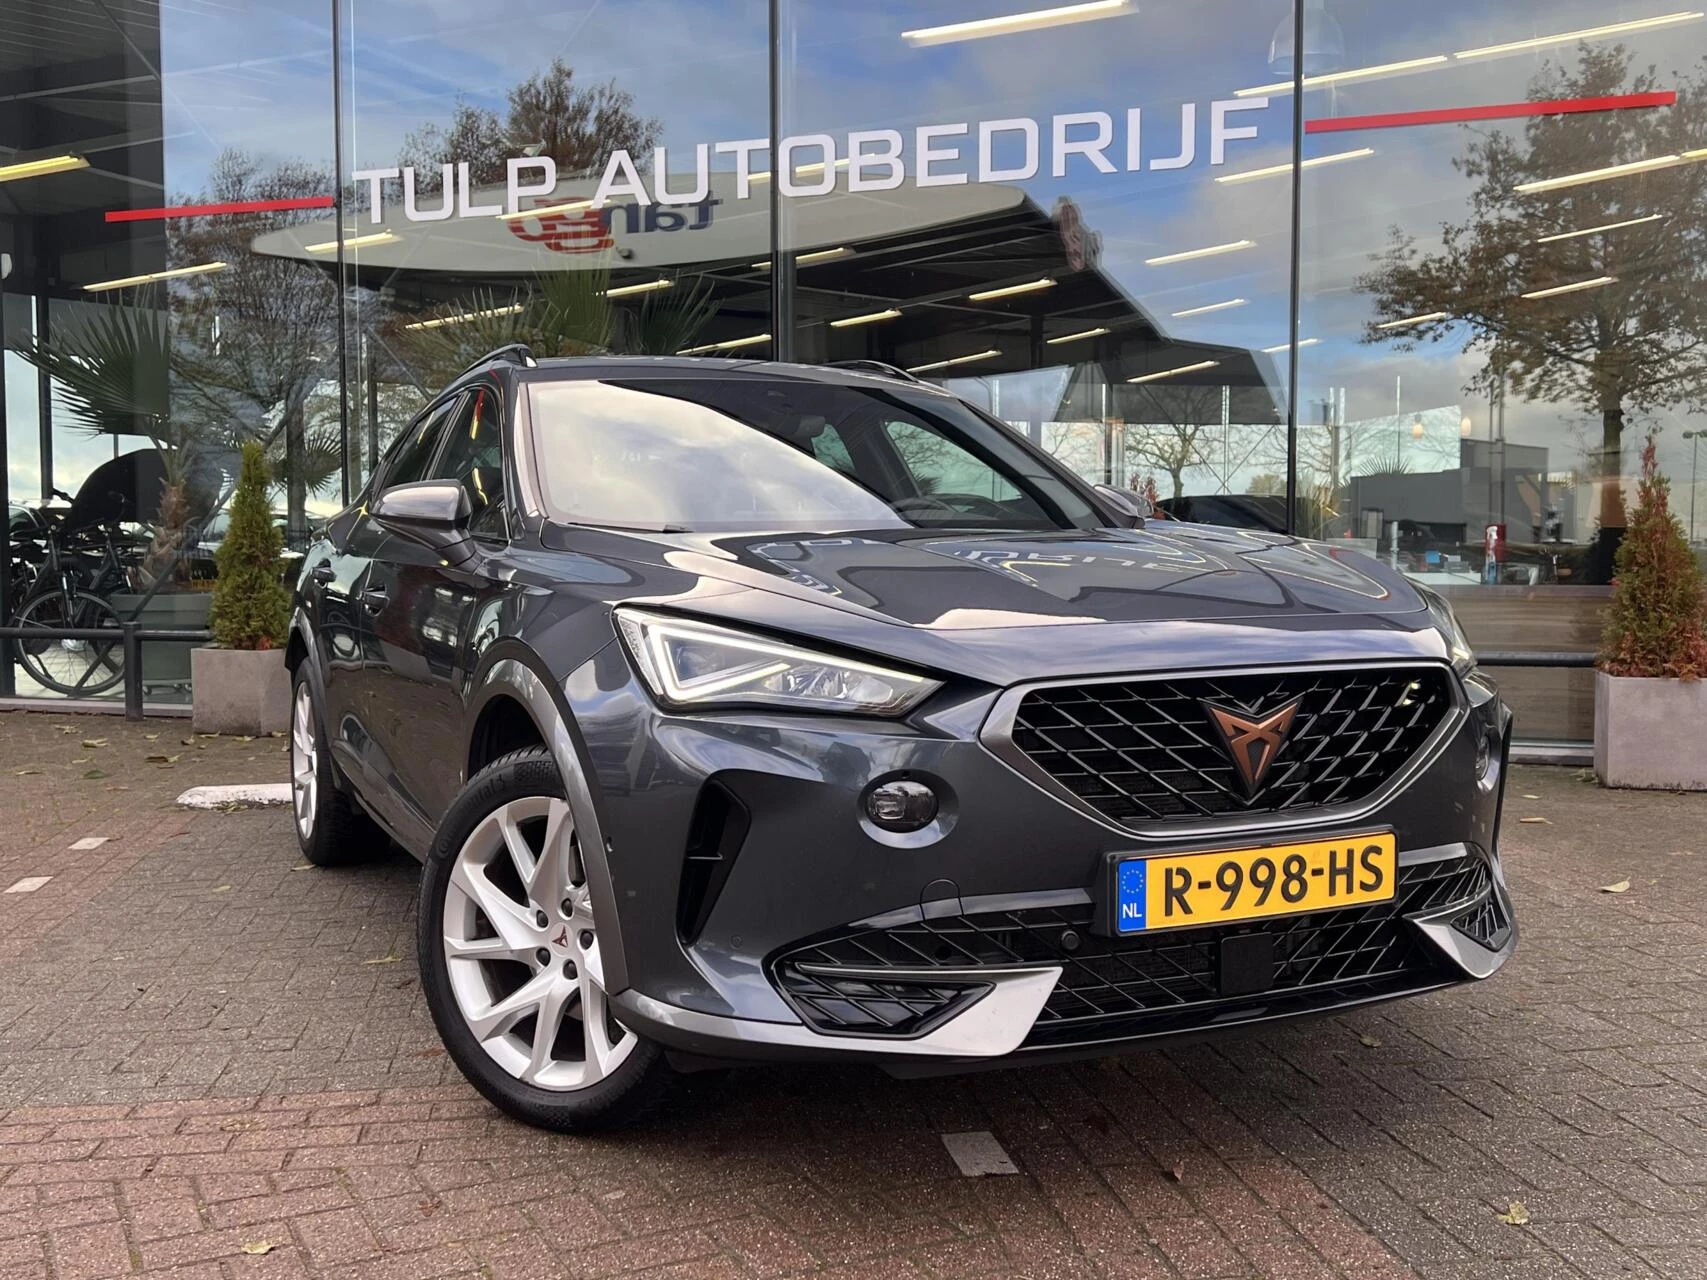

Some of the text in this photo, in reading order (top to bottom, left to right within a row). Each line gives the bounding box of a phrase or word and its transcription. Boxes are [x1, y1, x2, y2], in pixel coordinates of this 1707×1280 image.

[351, 97, 1270, 224] TULP AUTOBEDRIJF
[1122, 903, 1142, 919] NL
[1164, 845, 1383, 917] R-998-HS
